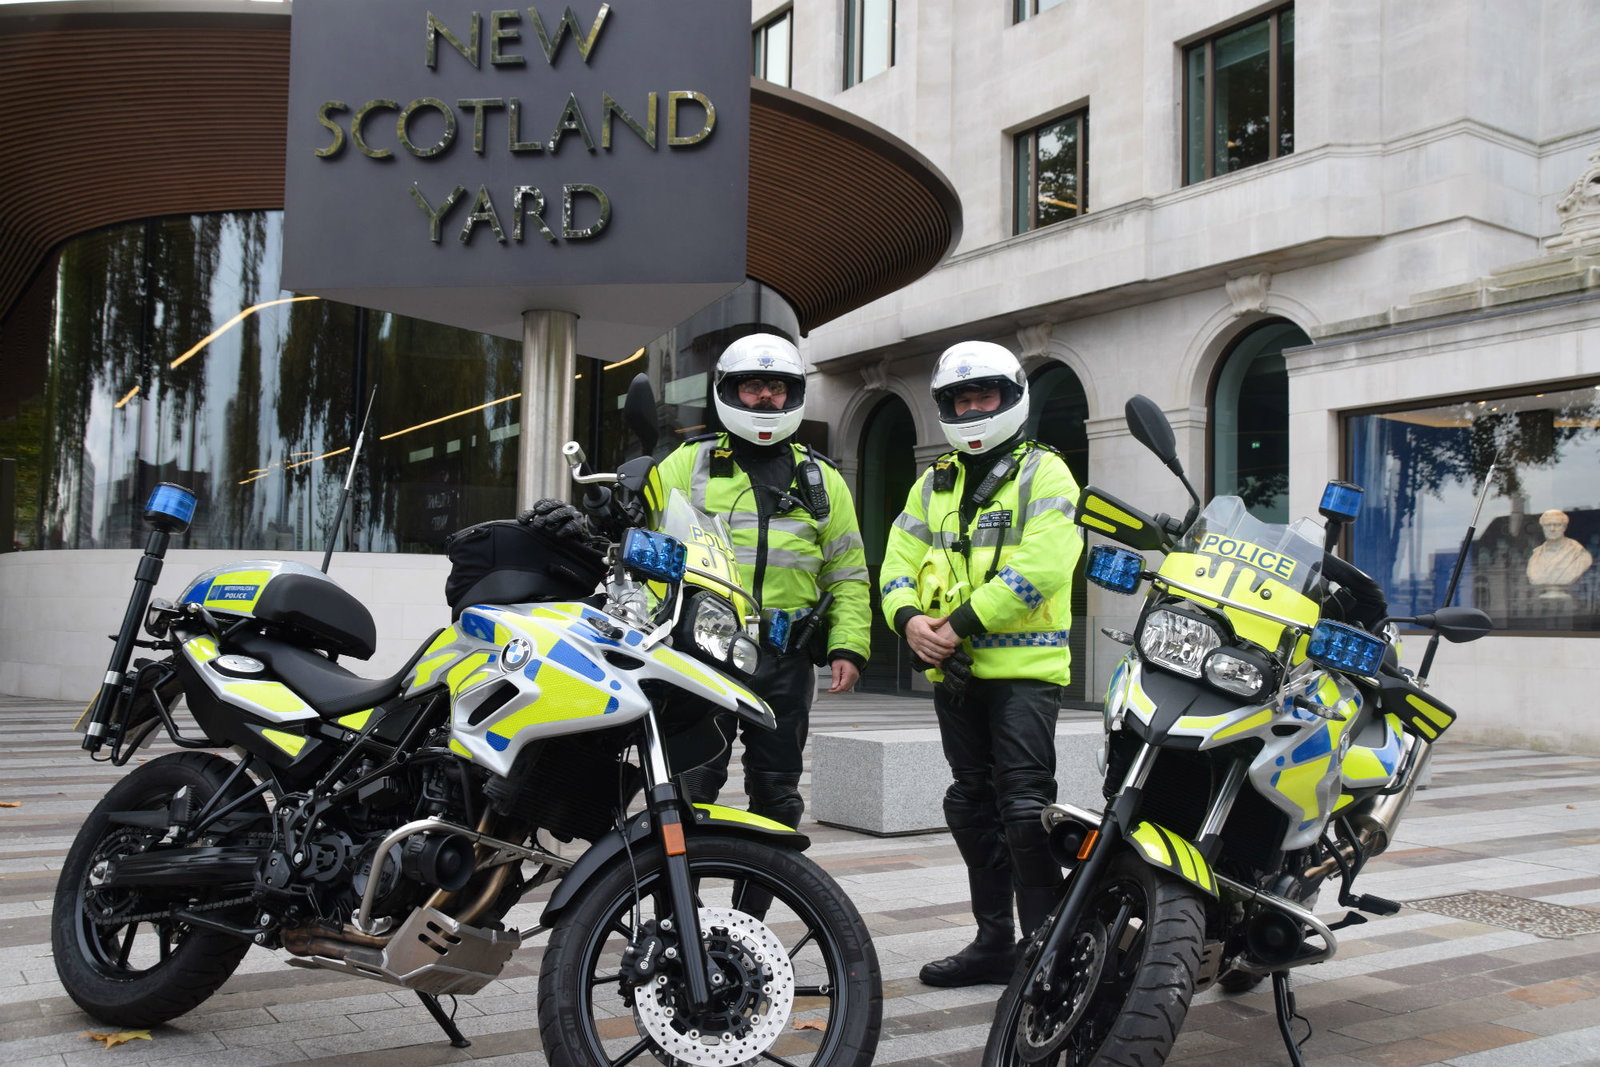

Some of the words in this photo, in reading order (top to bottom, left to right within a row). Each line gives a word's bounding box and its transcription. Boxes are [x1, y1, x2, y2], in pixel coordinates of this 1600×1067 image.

[424, 3, 611, 69] NEW
[314, 91, 717, 158] SCOTLAND
[408, 183, 612, 244] YARD
[1202, 535, 1294, 578] POLICE
